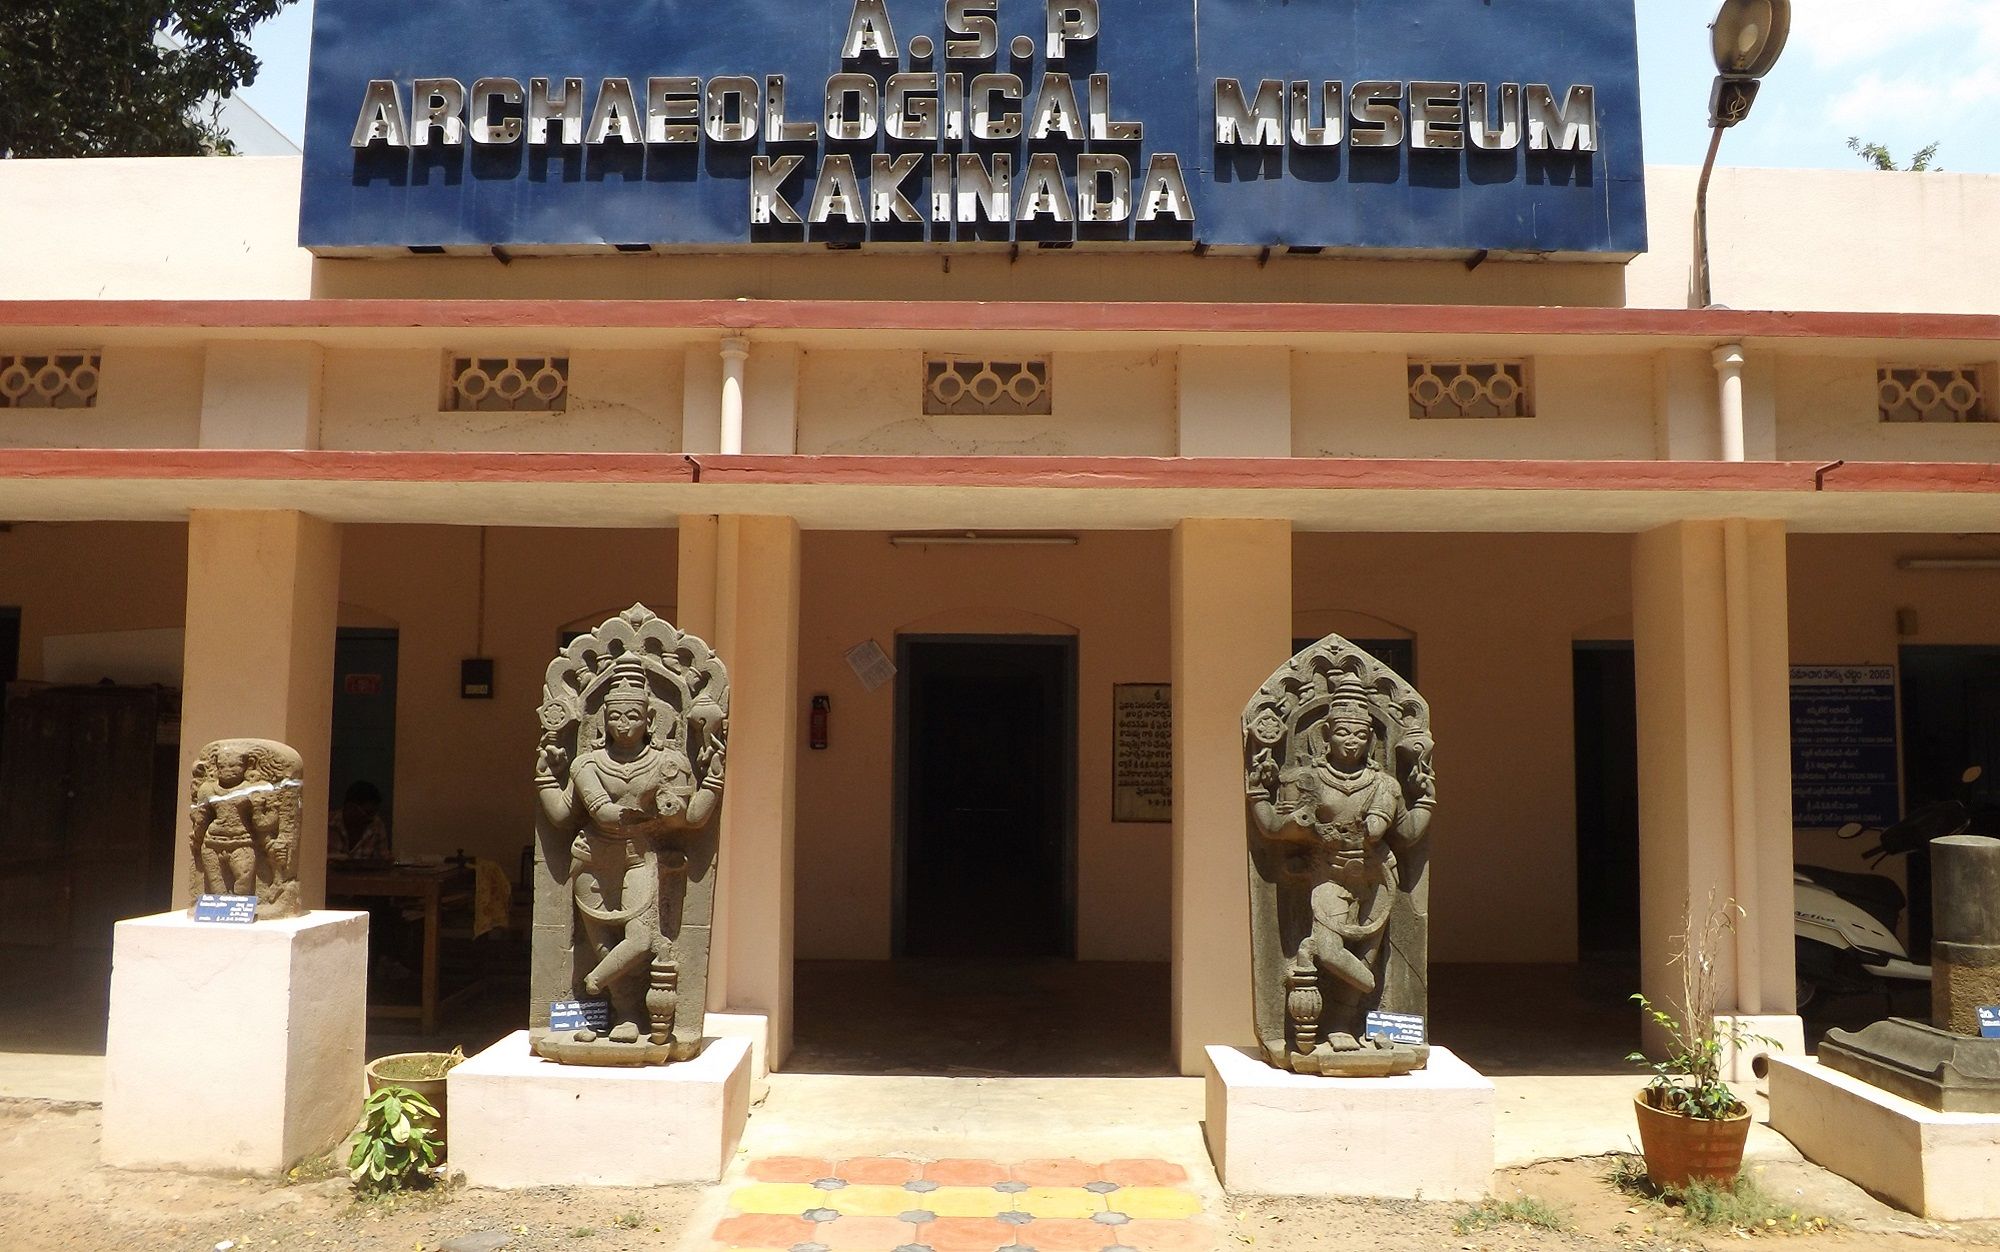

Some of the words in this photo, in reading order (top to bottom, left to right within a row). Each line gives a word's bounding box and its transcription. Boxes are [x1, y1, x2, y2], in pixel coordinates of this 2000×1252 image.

[841, 0, 1099, 59] A.S.P
[350, 72, 1144, 148] ARCHAEOLOGICAL
[1214, 77, 1598, 152] MUSEUM
[750, 153, 1195, 224] KAKINADA
[1869, 669, 1891, 679] 2005
